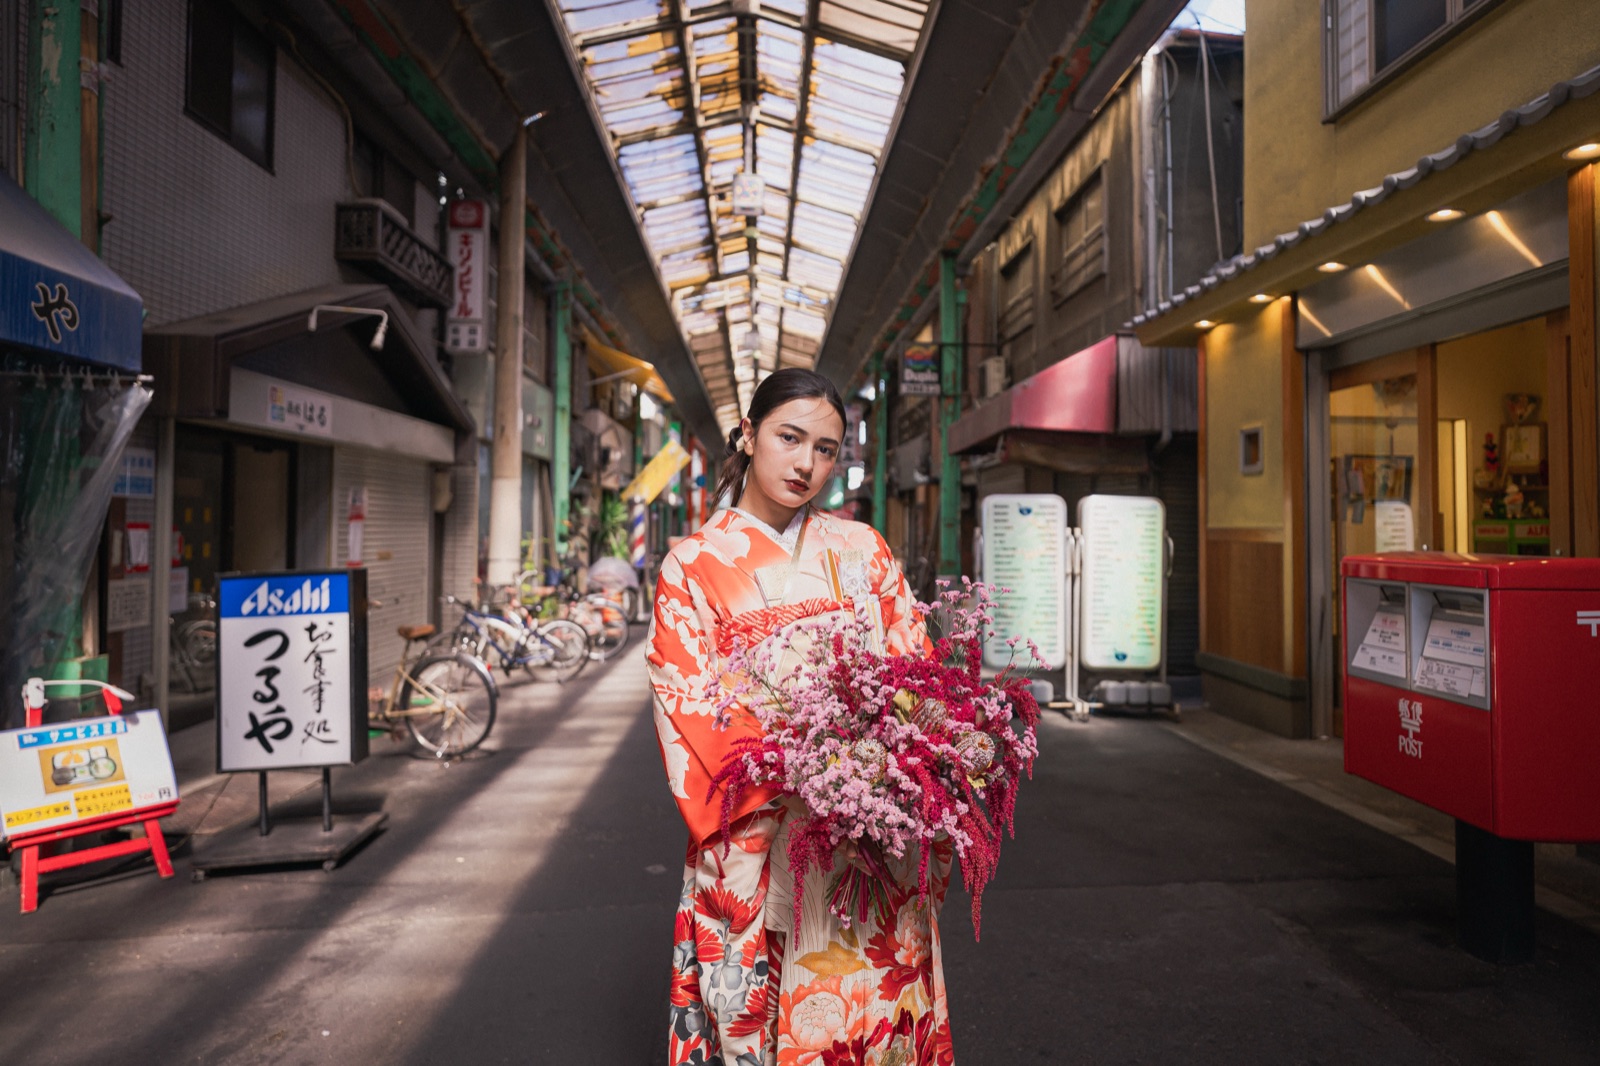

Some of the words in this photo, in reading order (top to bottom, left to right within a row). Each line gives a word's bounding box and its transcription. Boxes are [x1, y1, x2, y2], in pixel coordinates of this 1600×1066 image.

[457, 232, 473, 317] キリンビール
[31, 281, 80, 344] や
[241, 577, 330, 616] Asahi
[243, 628, 293, 754] つるや
[302, 621, 339, 745] お食事処
[1398, 697, 1423, 724] 郵便
[1398, 734, 1423, 760] POST
